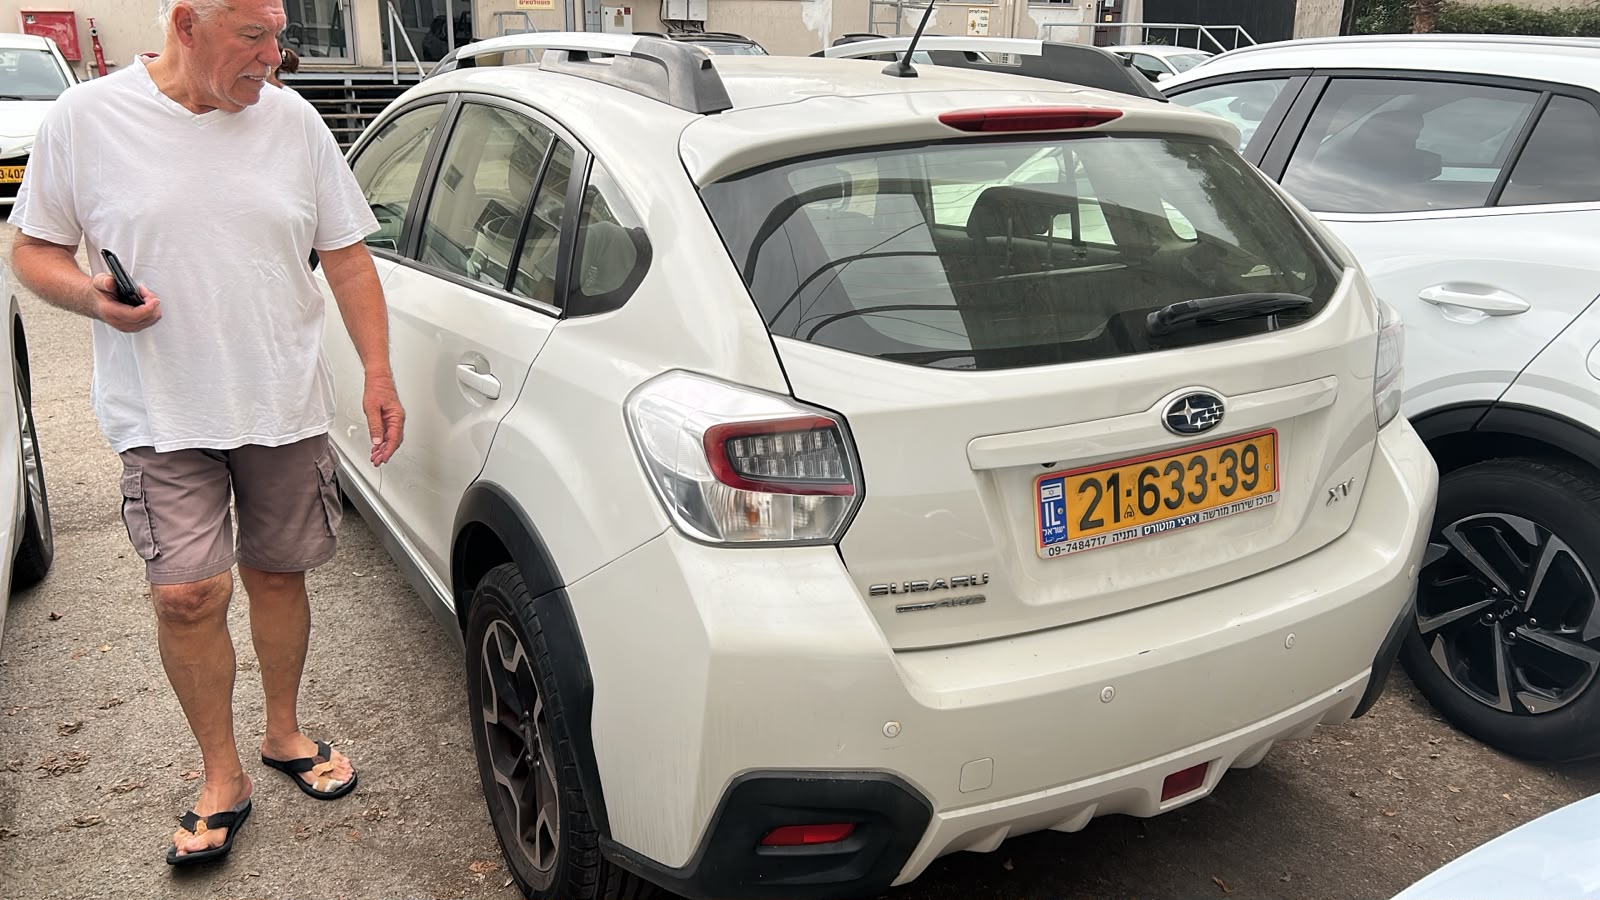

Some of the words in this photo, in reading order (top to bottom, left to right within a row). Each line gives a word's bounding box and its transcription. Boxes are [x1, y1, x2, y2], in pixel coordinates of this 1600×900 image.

[1326, 477, 1355, 506] XV
[1230, 499, 1254, 514] שירות
[1255, 494, 1273, 508] מרכז
[1044, 501, 1061, 527] IL
[1177, 514, 1198, 528] ארצי
[1202, 506, 1229, 521] מורשה
[1042, 525, 1066, 536] ישראל
[1112, 528, 1138, 543] נתניה
[1144, 521, 1176, 536] מוטורס
[1048, 535, 1107, 557] 09-7484717
[869, 572, 990, 596] SUBARU
